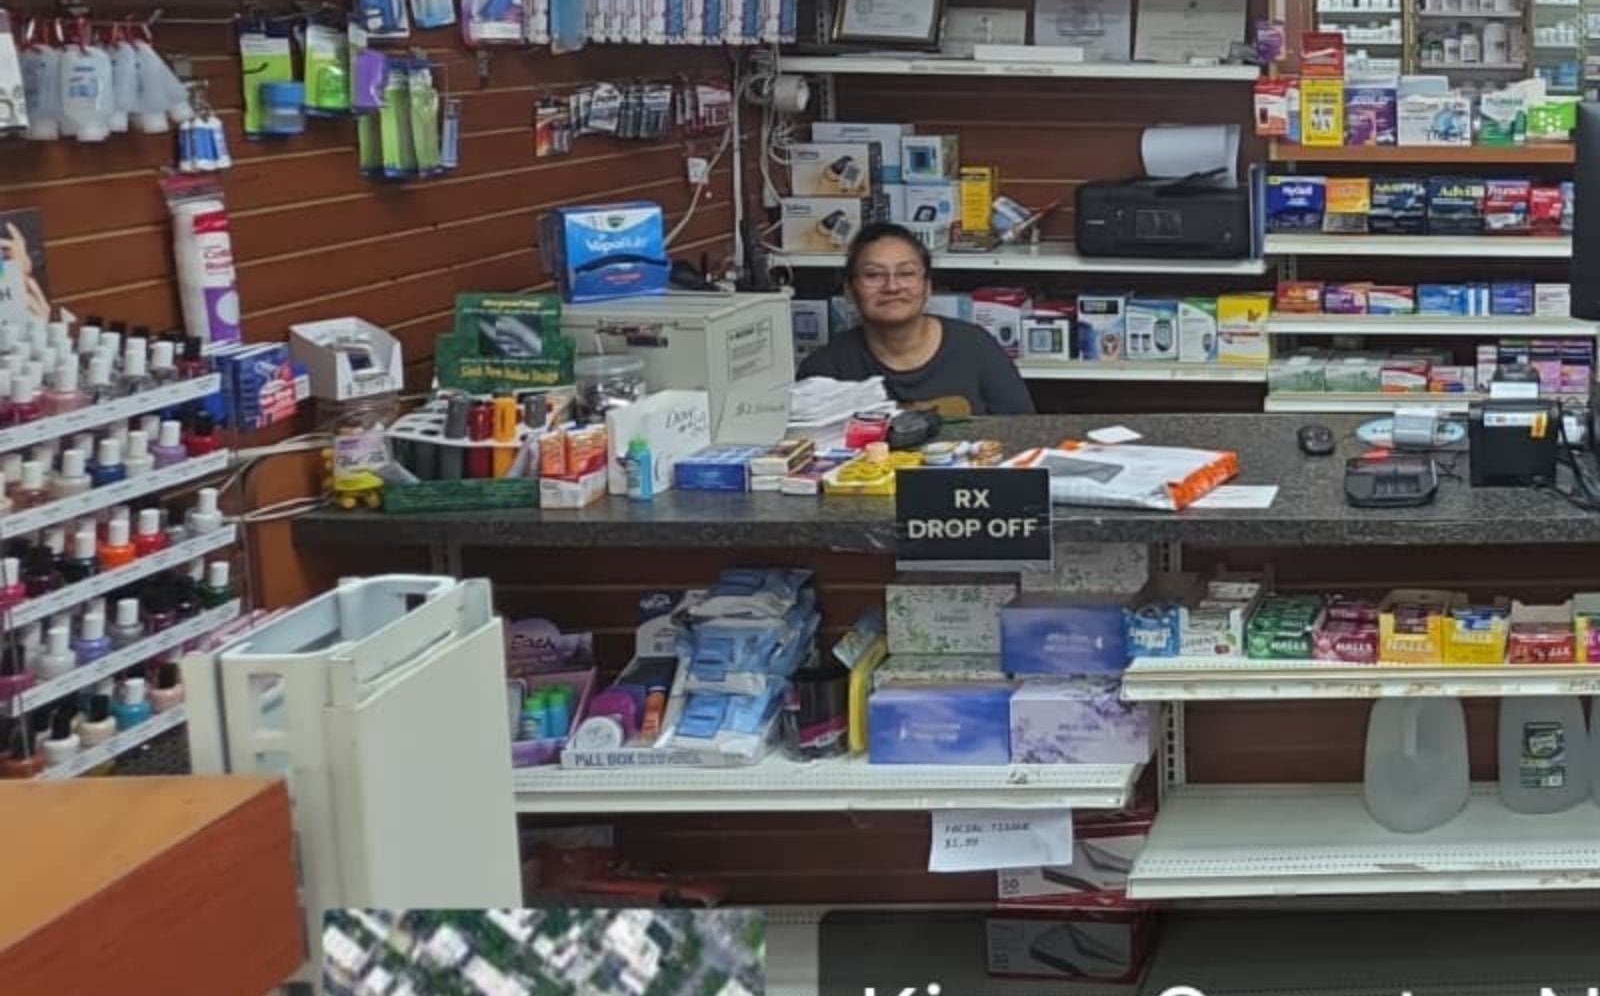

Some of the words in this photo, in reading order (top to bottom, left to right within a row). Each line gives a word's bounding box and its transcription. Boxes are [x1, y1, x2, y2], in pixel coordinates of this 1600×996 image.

[953, 488, 990, 510] RX
[907, 519, 981, 541] DROP
[987, 517, 1038, 539] OFF
[1270, 641, 1307, 652] HALLS
[1336, 641, 1374, 653] HALLS
[945, 824, 982, 834] FACIAL
